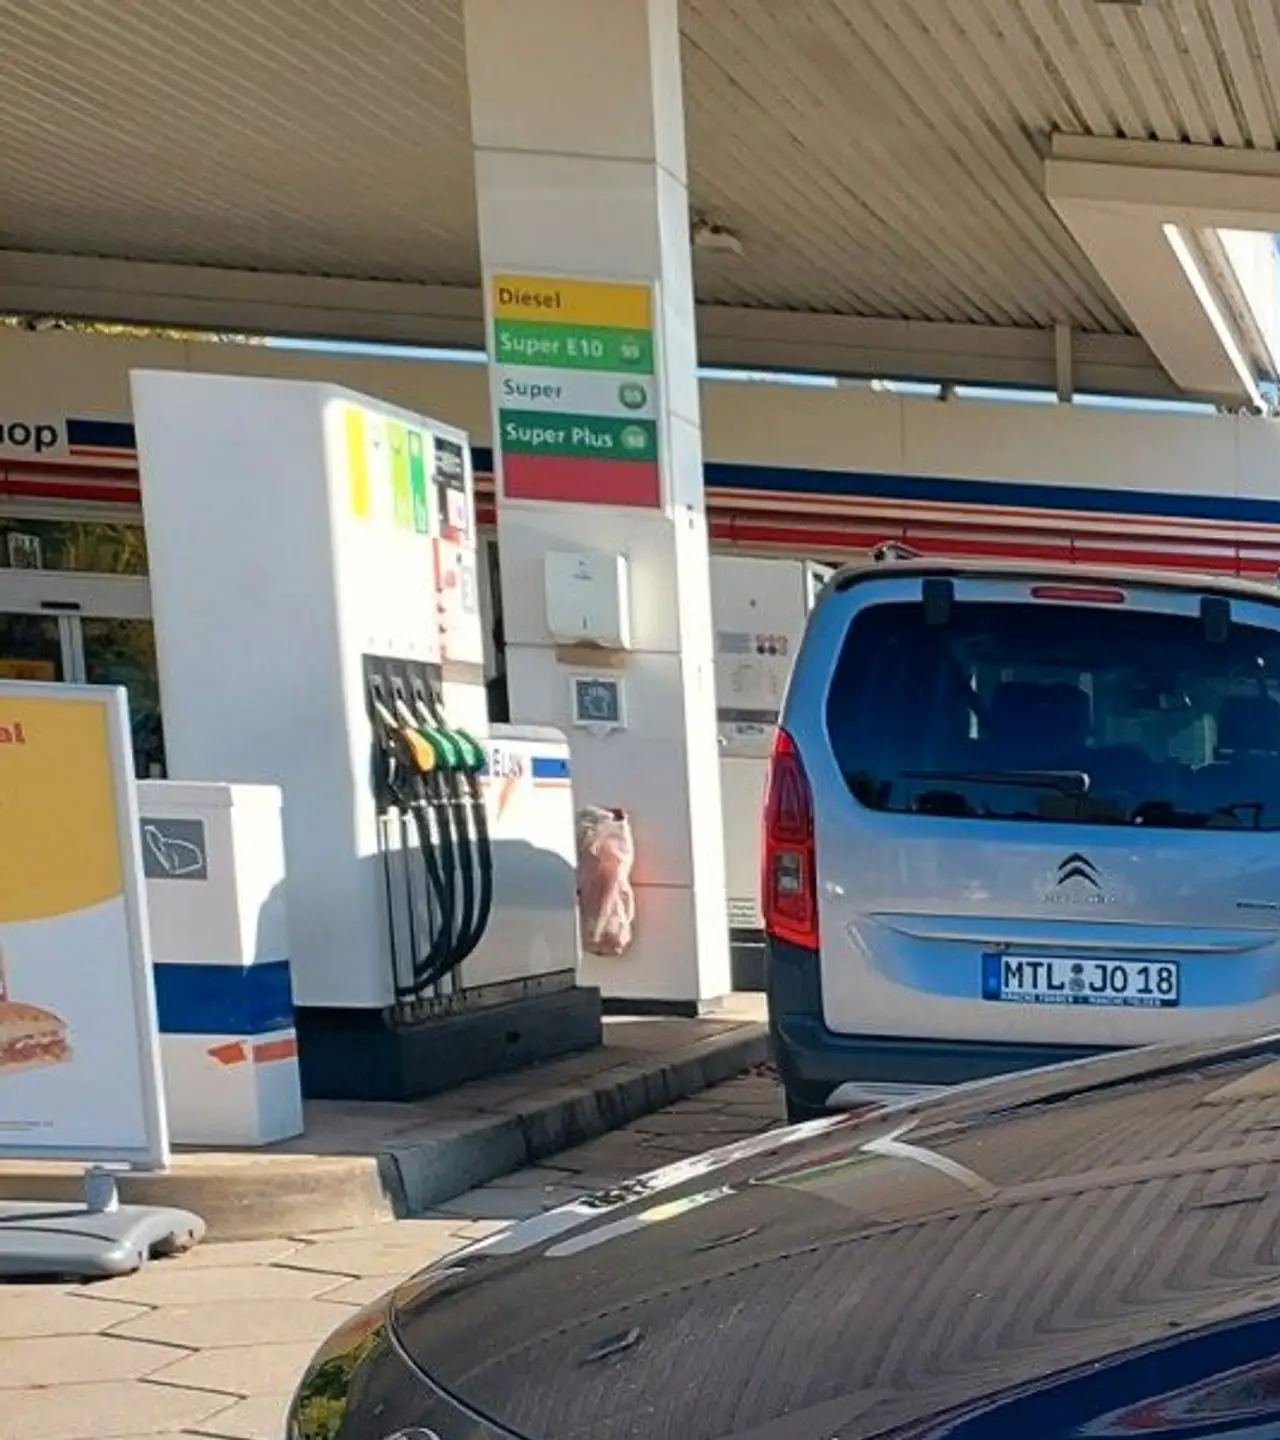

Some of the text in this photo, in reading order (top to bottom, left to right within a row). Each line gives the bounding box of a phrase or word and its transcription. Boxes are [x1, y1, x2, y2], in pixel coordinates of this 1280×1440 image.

[499, 287, 561, 309] Diesel
[500, 333, 561, 355] Super
[566, 338, 604, 358] E10
[503, 379, 562, 400] Super
[0, 422, 58, 453] op
[506, 423, 565, 446] Super
[572, 428, 614, 448] Plus
[1002, 960, 1065, 990] MTL
[1136, 965, 1174, 996] 18
